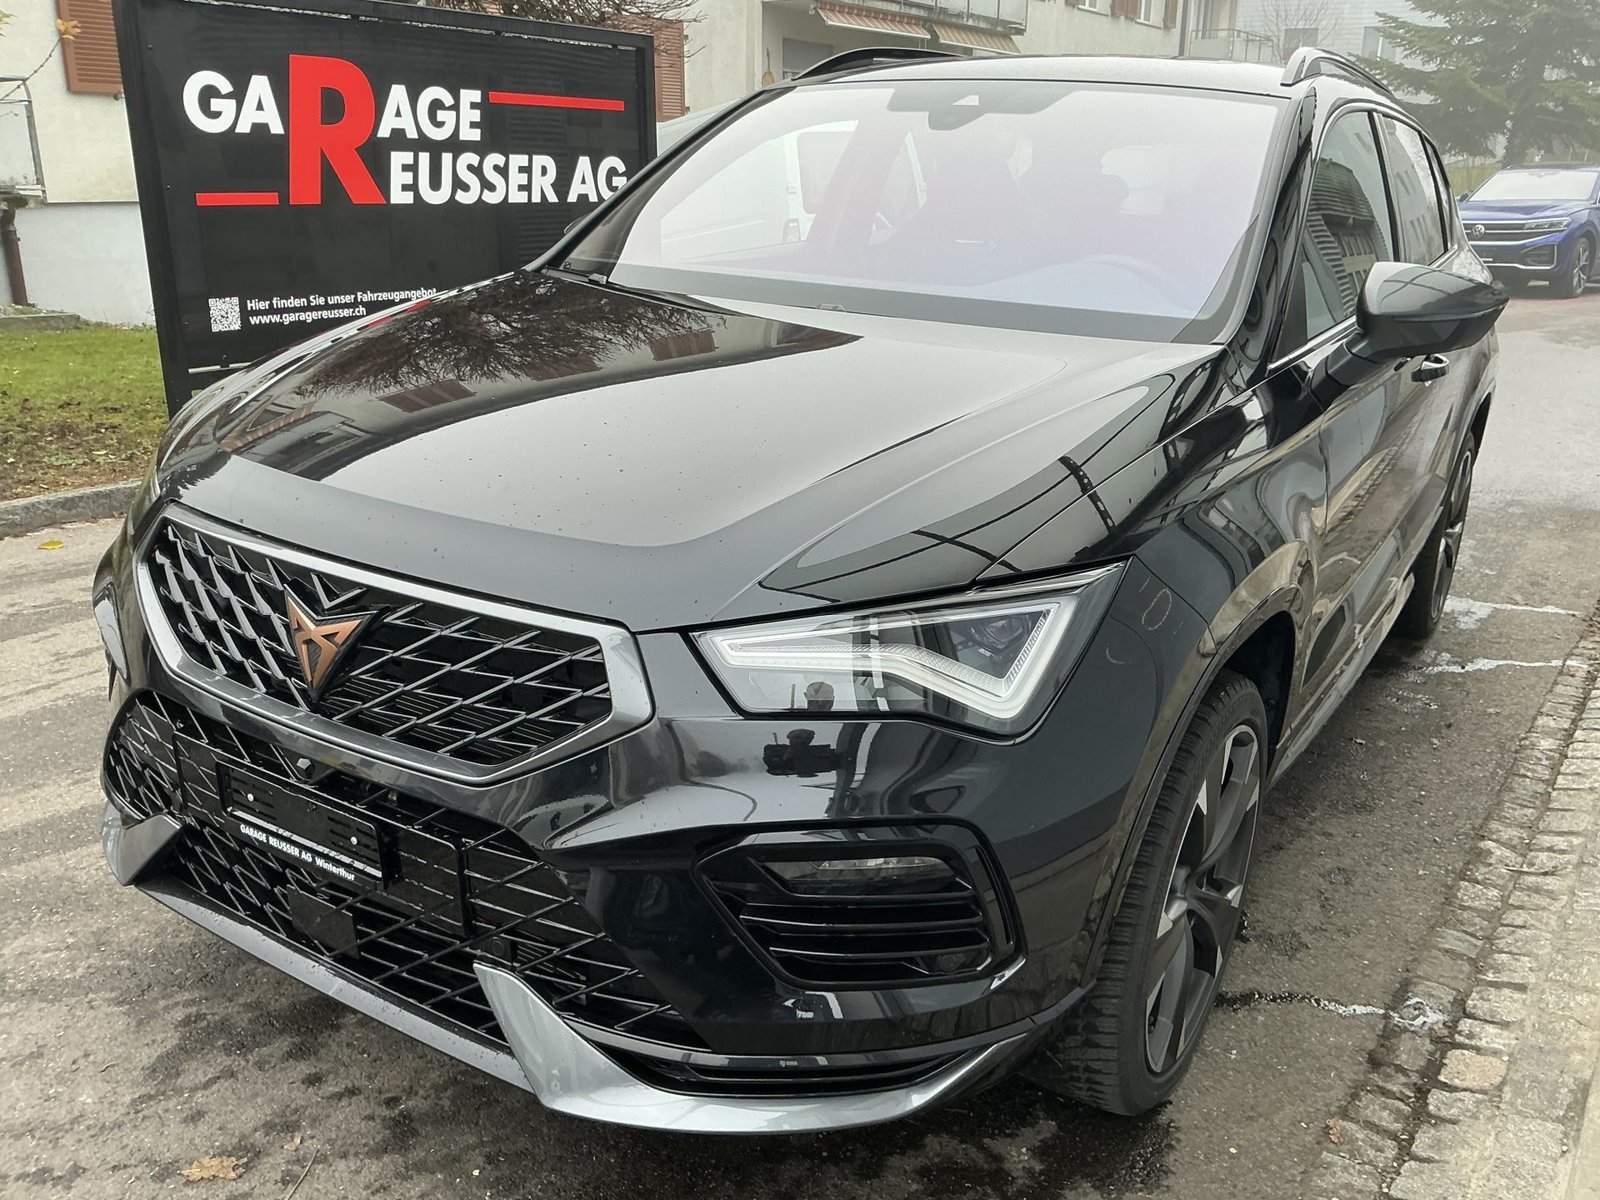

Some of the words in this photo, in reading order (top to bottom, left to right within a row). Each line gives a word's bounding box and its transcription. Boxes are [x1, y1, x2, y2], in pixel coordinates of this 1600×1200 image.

[567, 154, 628, 204] AG
[247, 298, 270, 311] Hier
[273, 296, 307, 309] finden
[309, 294, 326, 306] Sie
[327, 294, 356, 305] unser
[249, 305, 367, 325] www.garagereusser.ch
[240, 824, 268, 843] GARAGE
[269, 835, 300, 858] REUSSER
[300, 850, 313, 863] AG
[315, 856, 355, 881] Winterthur
